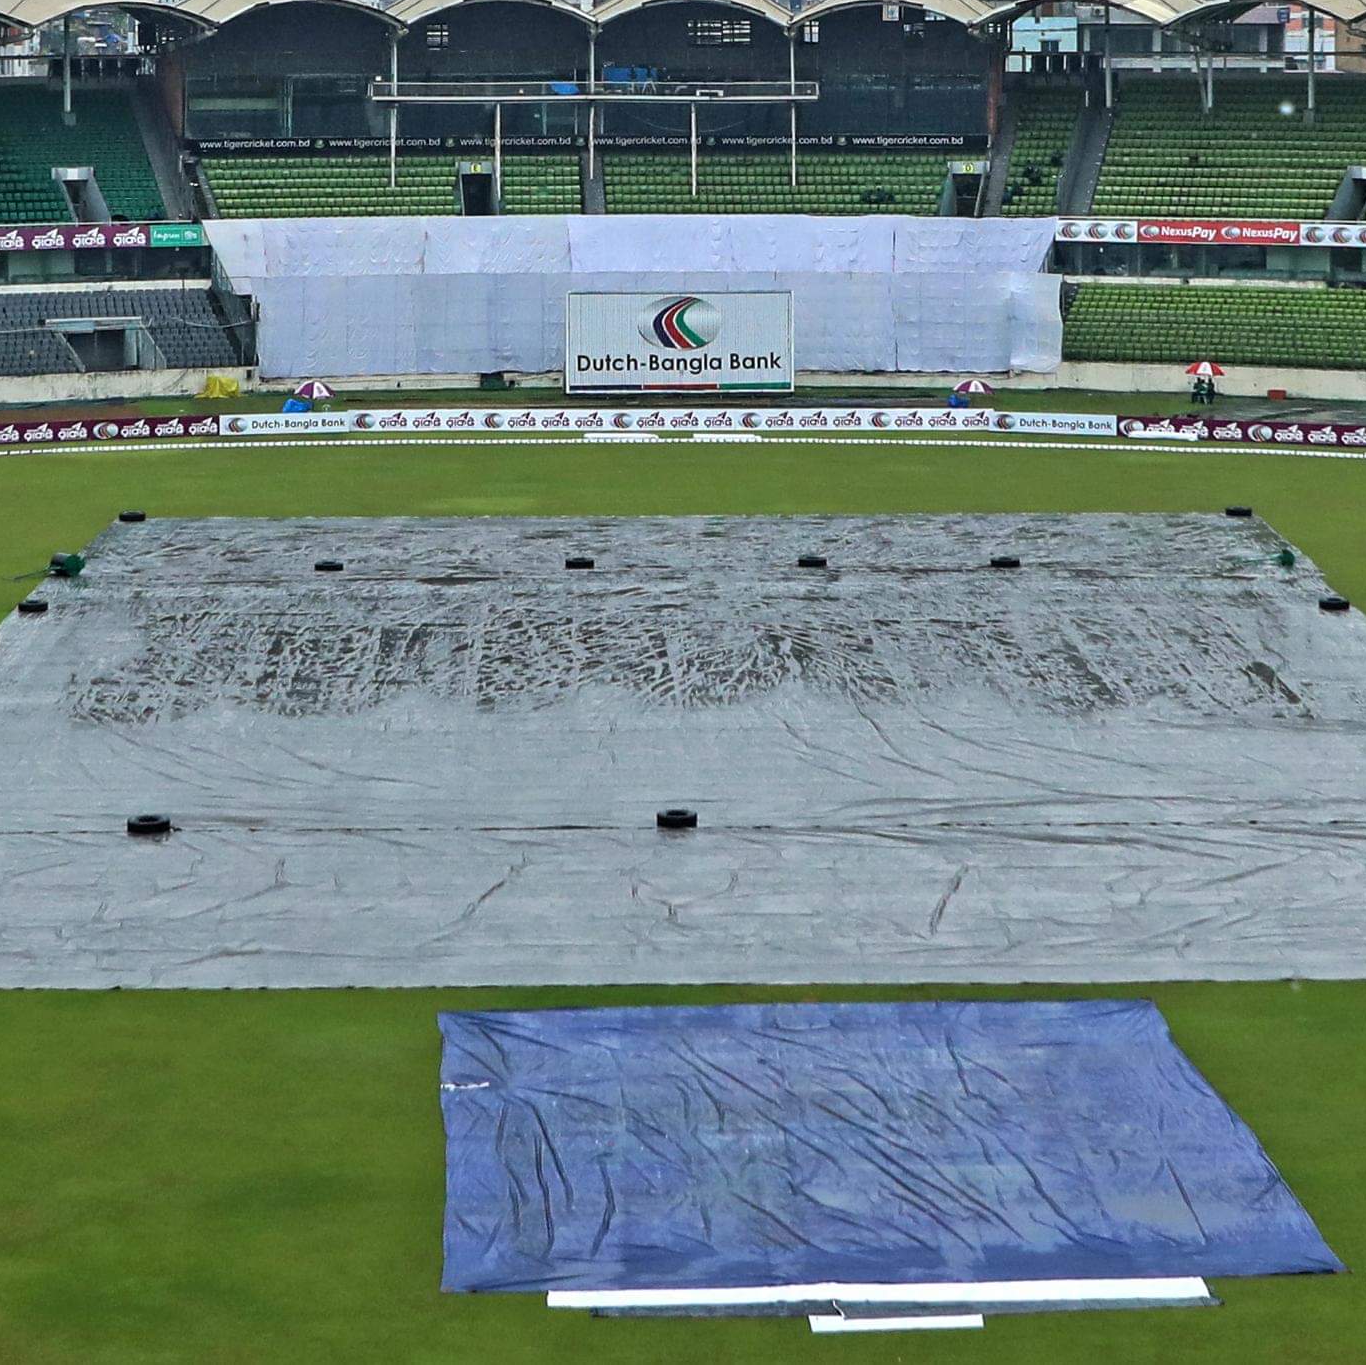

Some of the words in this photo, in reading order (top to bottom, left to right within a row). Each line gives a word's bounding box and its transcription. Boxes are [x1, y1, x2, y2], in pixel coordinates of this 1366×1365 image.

[199, 139, 311, 150] www.tigercricket.com.bd
[329, 138, 441, 148] www.tigercricet.com.bd
[852, 135, 964, 146] www.tigercricket.com.bd
[1161, 226, 1216, 241] NexusPay
[1241, 227, 1298, 243] NexusPay
[577, 353, 722, 375] Dutch-Bangla
[730, 352, 782, 370] Bank
[252, 419, 318, 431] Dutch-Bangla
[322, 418, 345, 428] Bank
[1019, 418, 1083, 432] Dutch-Bangla
[1087, 420, 1112, 430] Bank
